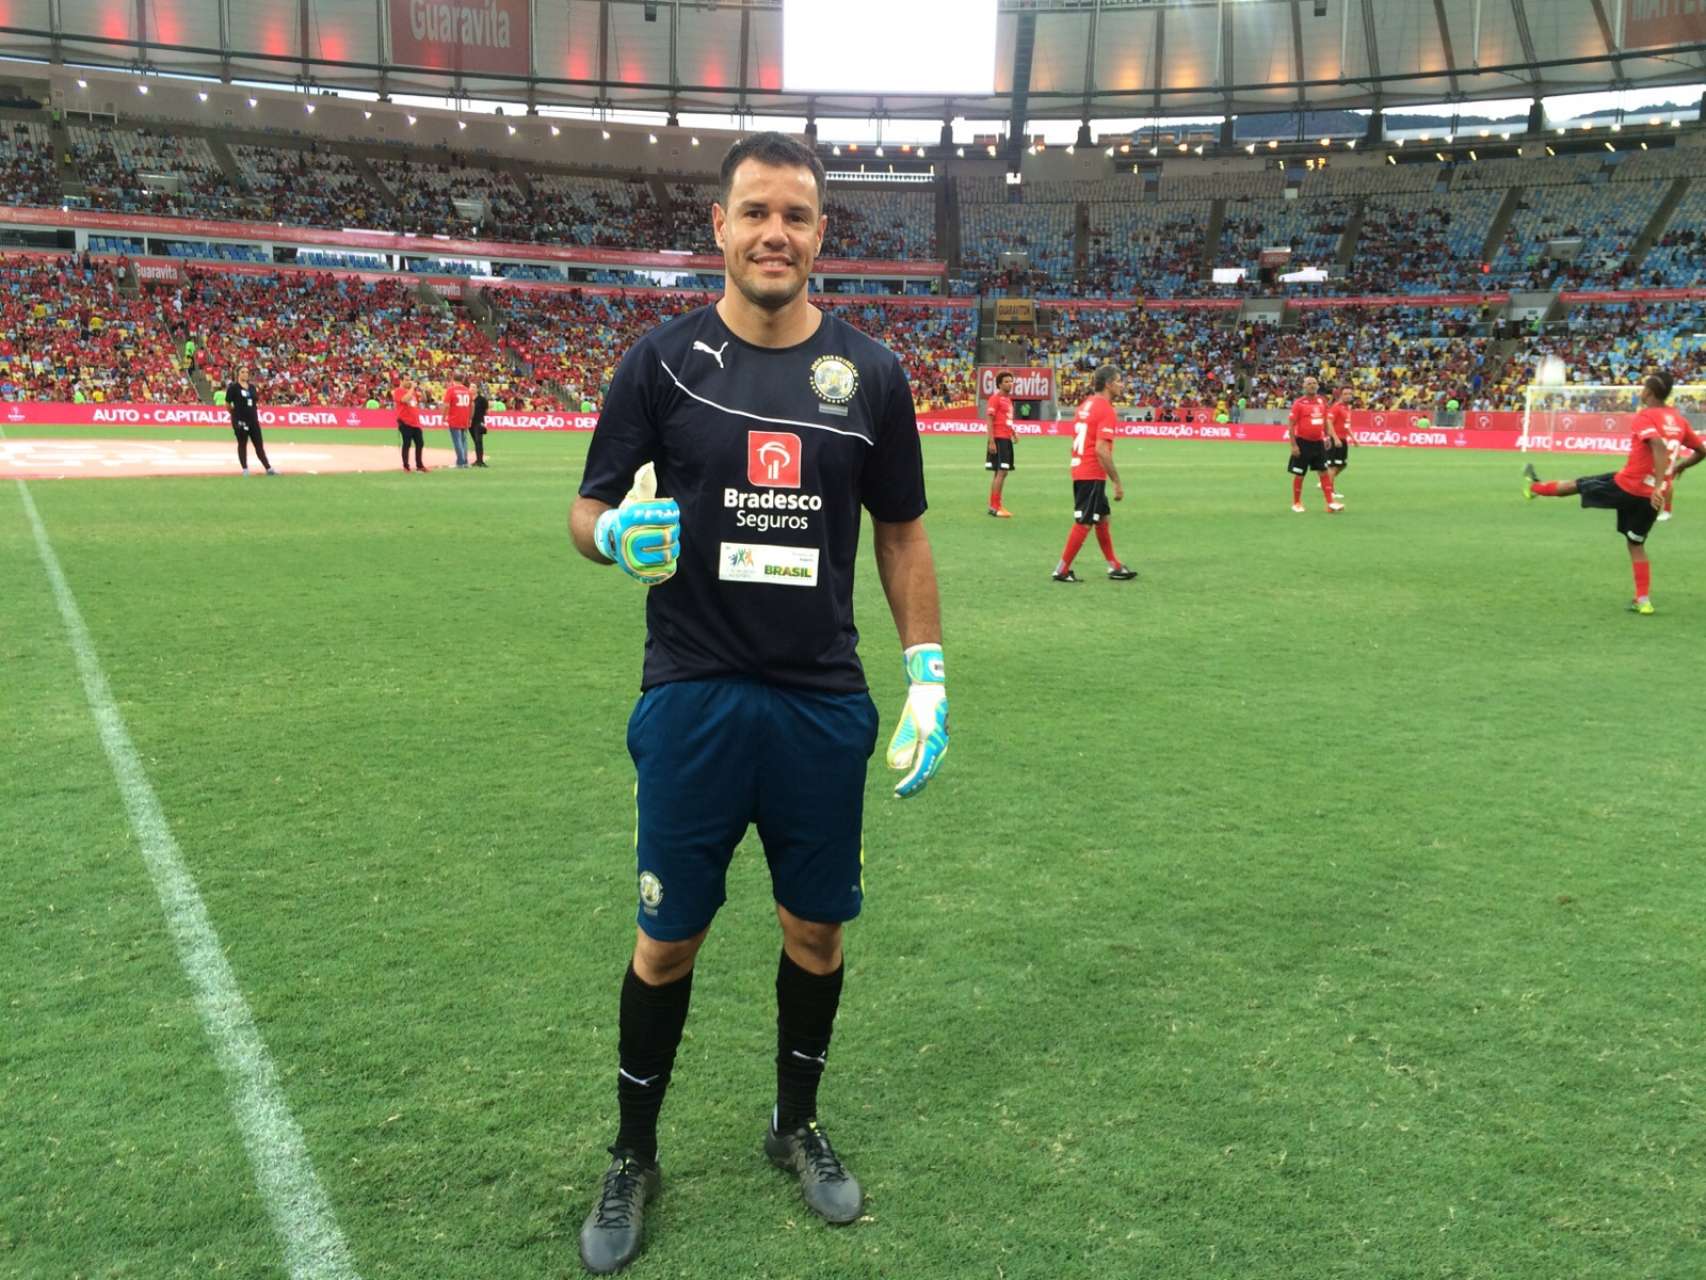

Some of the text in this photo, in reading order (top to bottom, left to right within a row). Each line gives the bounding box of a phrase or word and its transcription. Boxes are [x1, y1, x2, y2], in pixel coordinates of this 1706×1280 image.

[410, 0, 511, 48] Guaravita
[93, 409, 139, 422] AUTO
[288, 412, 337, 425] DENTA
[418, 414, 600, 430] AUT PITALIZAÇÃO DEN
[1125, 424, 1193, 438] CAPITALIZAÇÃO
[1200, 427, 1231, 437] DENTA
[1355, 429, 1400, 446] LIZAÇÃO
[1409, 432, 1447, 444] DENTA
[1515, 435, 1633, 450] AUTO CAPITALIZ
[724, 488, 822, 511] Bradesco
[736, 510, 809, 532] Seguros
[764, 564, 813, 578] BRASIL
